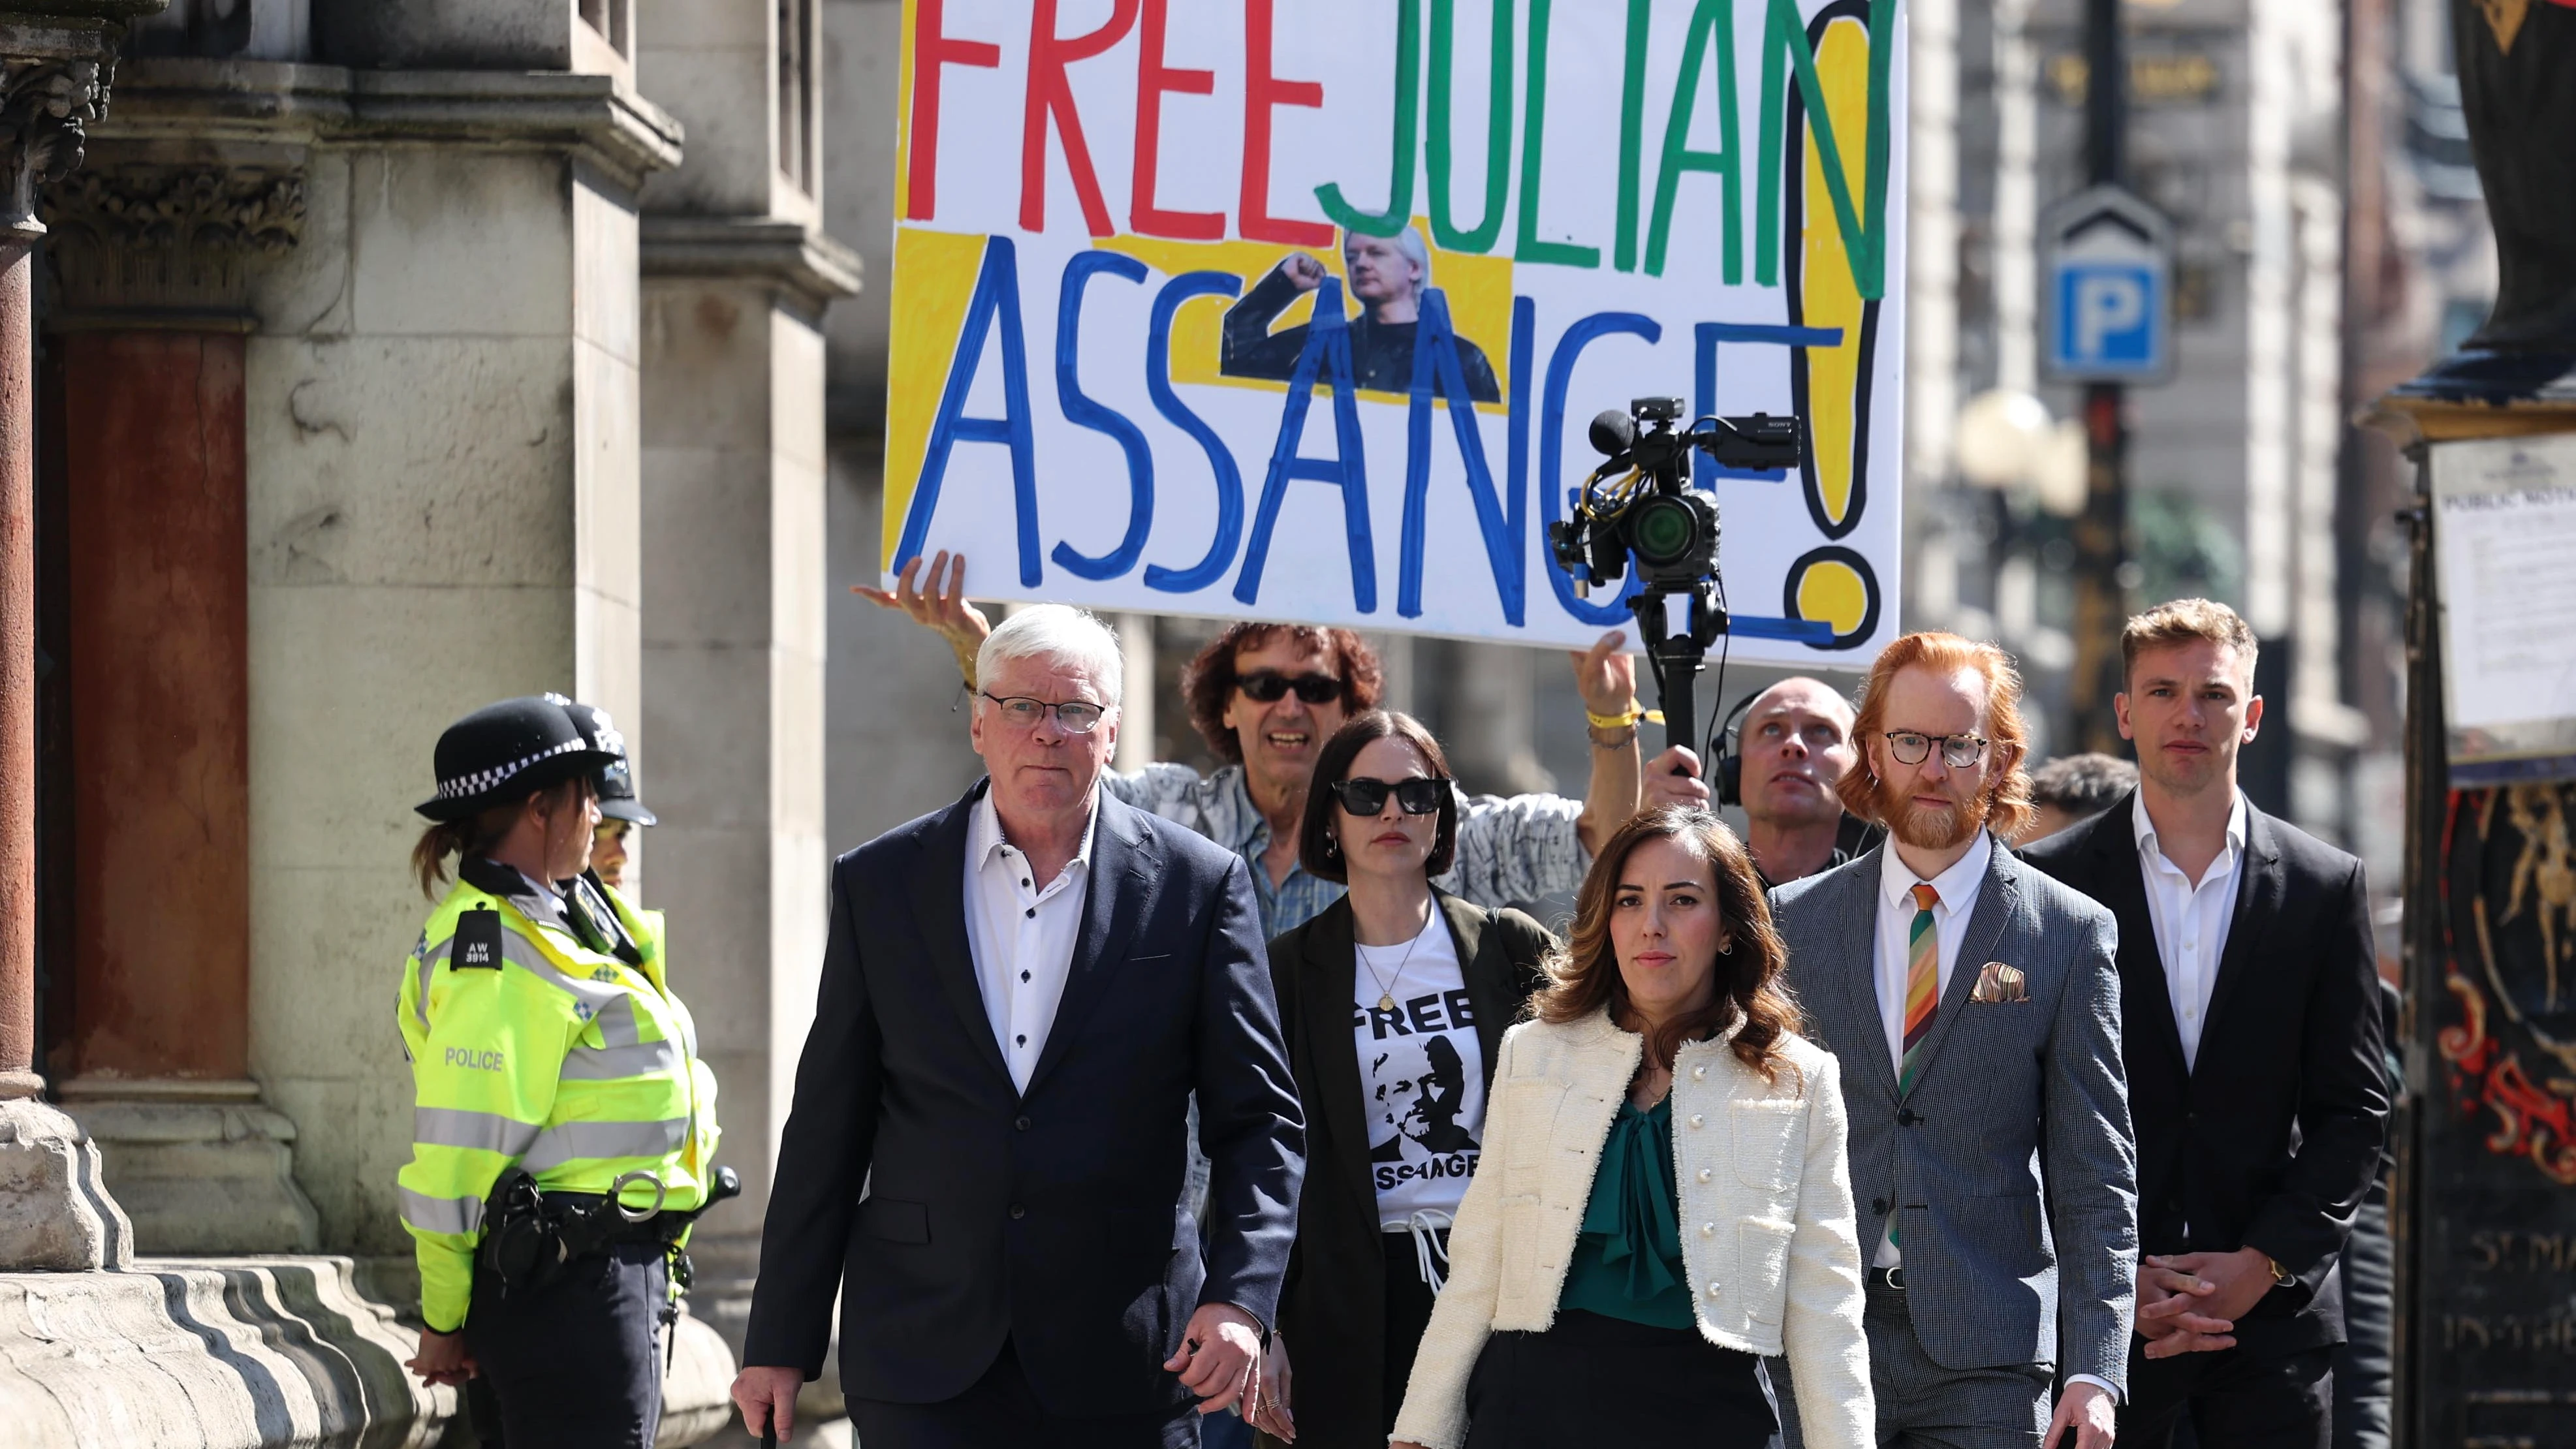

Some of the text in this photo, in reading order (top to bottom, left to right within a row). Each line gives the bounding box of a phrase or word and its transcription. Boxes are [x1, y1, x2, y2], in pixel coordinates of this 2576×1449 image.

[906, 0, 1891, 301] FREE JULIAN
[2077, 277, 2142, 356] P
[469, 942, 488, 953] AW
[445, 1047, 504, 1072] POLICE
